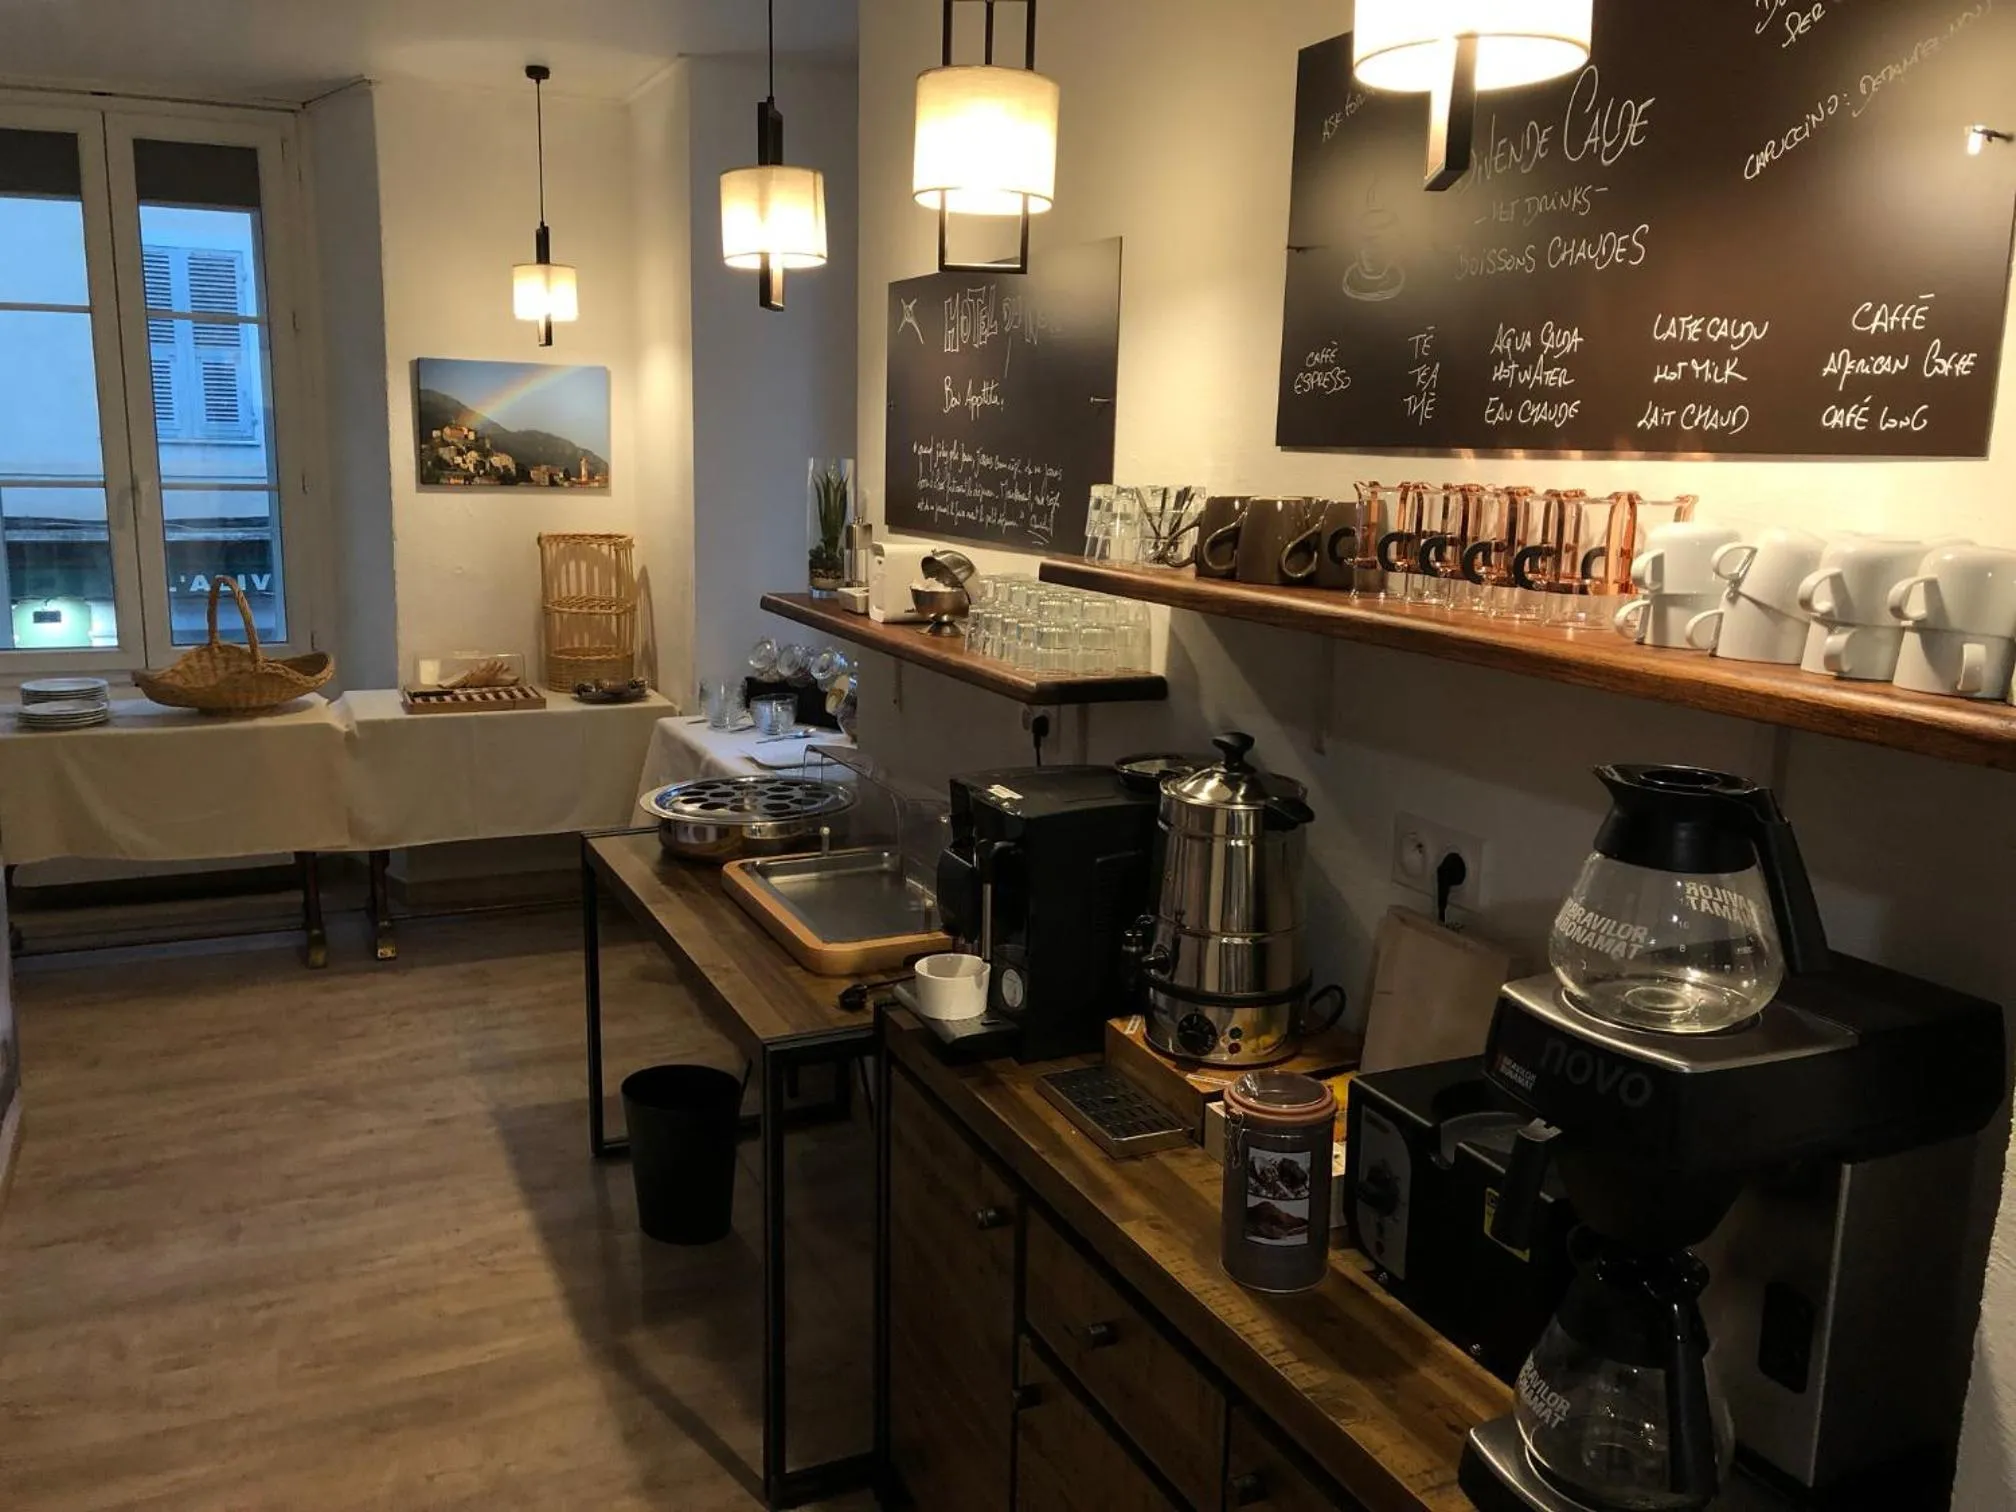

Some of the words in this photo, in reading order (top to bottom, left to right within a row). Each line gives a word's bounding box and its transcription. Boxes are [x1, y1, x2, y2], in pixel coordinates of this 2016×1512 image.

[1781, 2, 1826, 48] PER
[1547, 223, 1651, 271] CHAUDES
[1294, 366, 1352, 395] ESPRESSO
[1408, 361, 1440, 391] TEA
[1492, 360, 1519, 388] HOT
[1518, 353, 1576, 390] WATER
[1691, 356, 1748, 384] MILK
[1484, 396, 1513, 426] EAU
[1518, 399, 1581, 428] CHAUDE
[1636, 400, 1676, 431] LAIT
[1680, 402, 1750, 435] CHAUD
[1821, 394, 1874, 432] CAFÉ
[1559, 914, 1644, 961] BONAMAT
[1564, 896, 1648, 944] BRAVILOR
